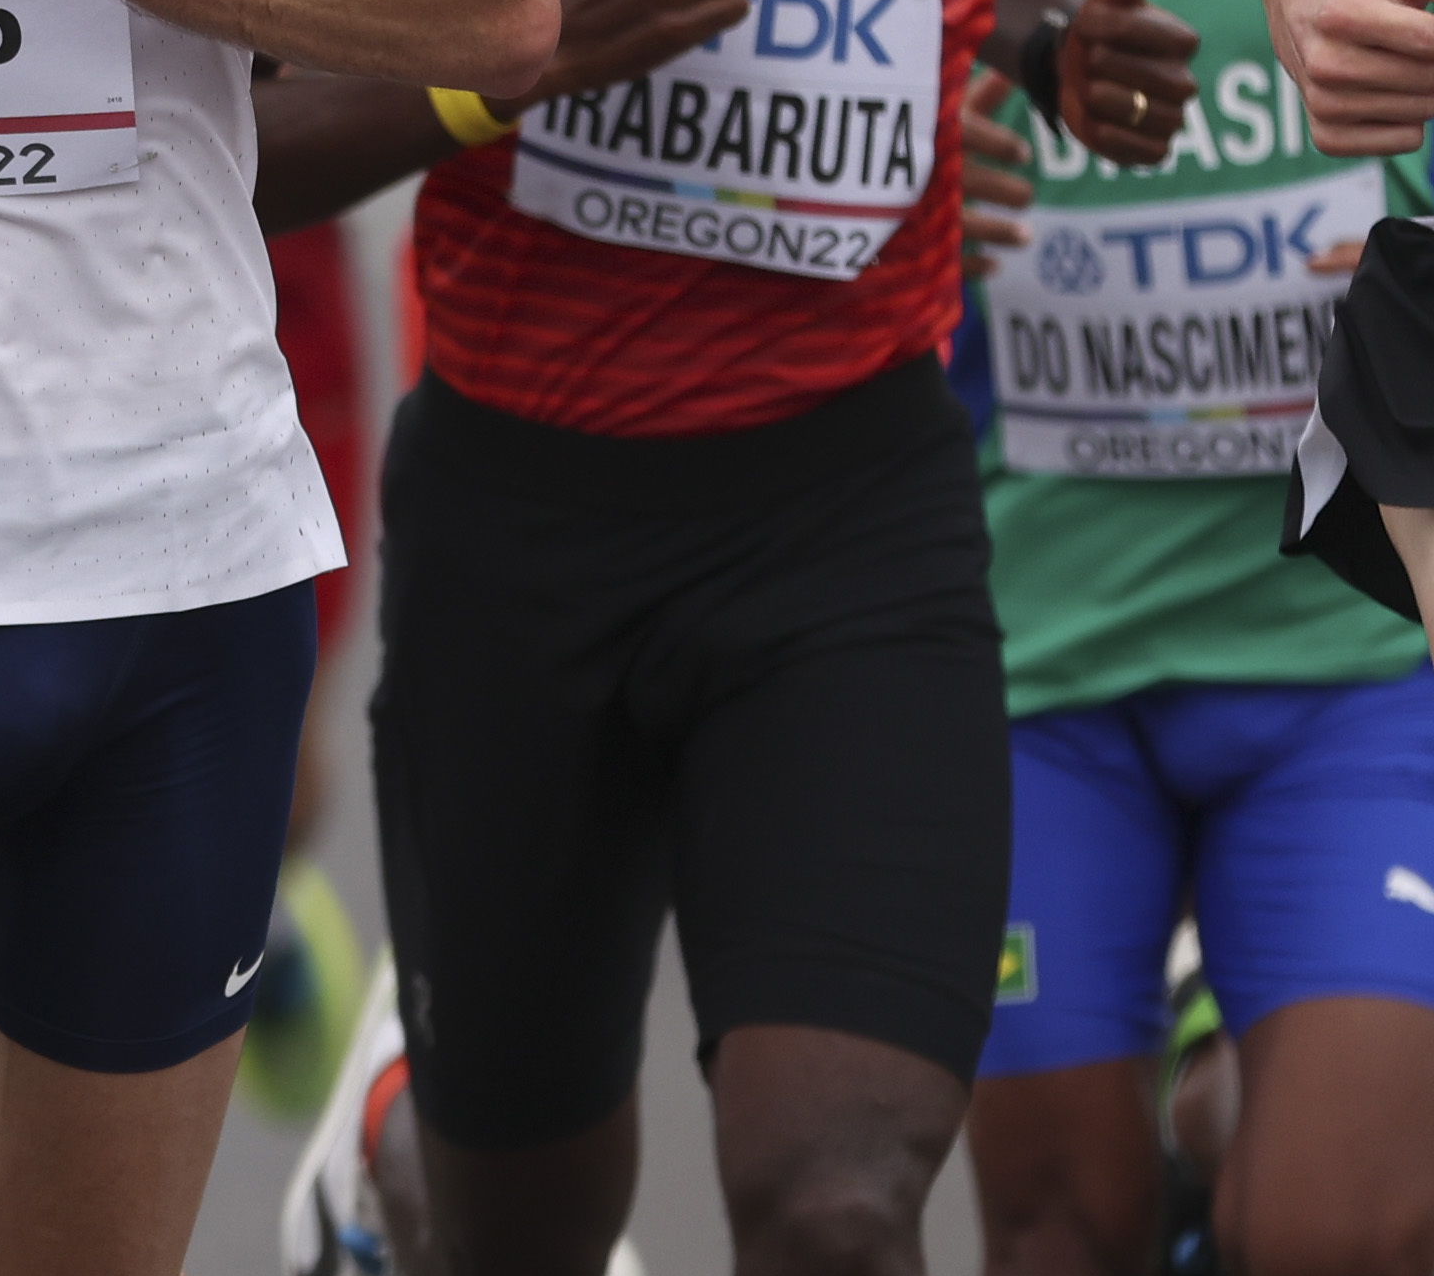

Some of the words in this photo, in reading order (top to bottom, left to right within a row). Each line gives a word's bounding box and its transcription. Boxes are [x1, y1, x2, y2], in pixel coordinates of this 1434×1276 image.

[574, 187, 872, 271] OREGON22
[1103, 201, 1324, 292] TDK
[1012, 311, 1072, 397] DO
